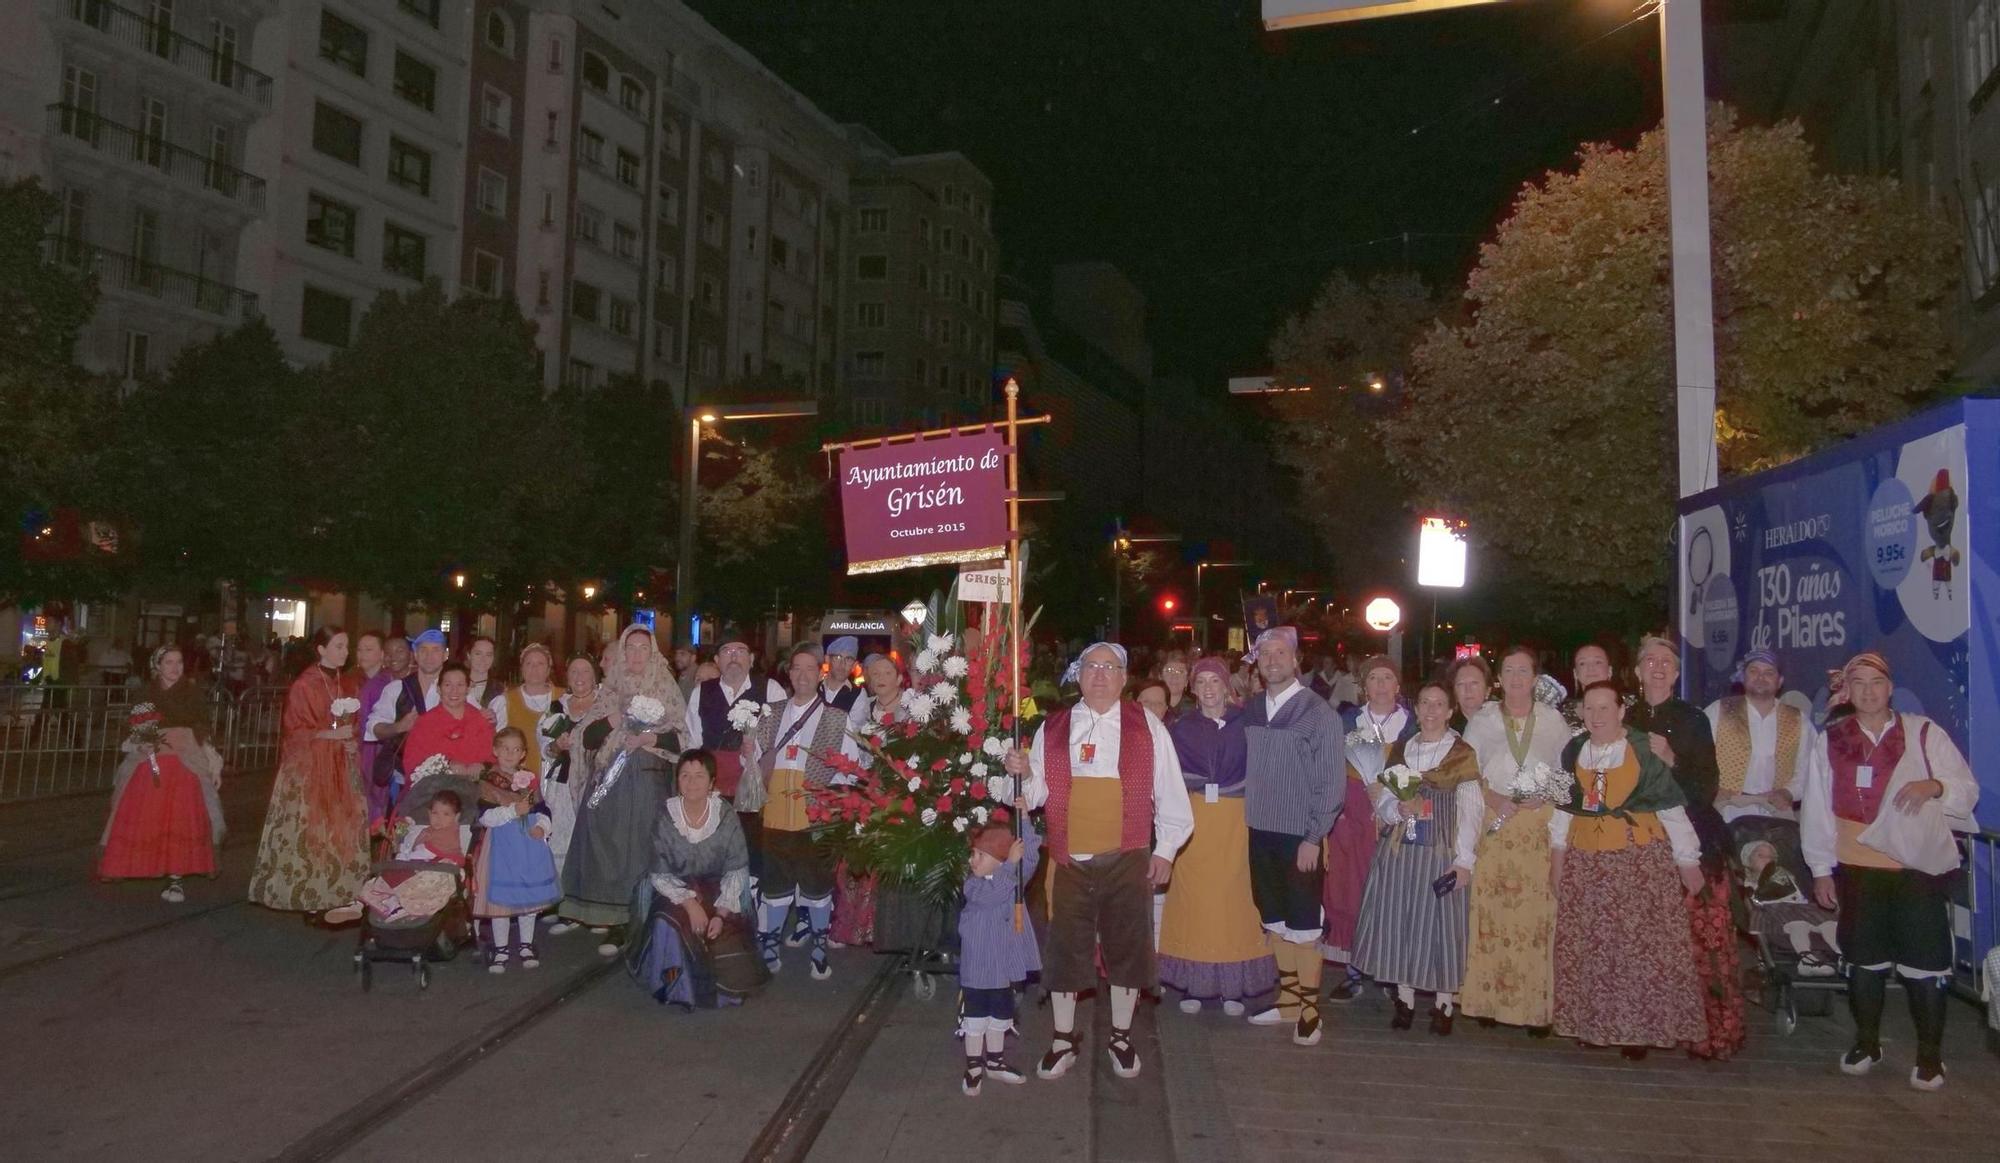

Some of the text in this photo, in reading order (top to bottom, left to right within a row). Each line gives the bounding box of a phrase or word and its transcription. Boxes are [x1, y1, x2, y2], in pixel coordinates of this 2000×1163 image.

[846, 448, 999, 490] Ayuntamiento de
[887, 481, 965, 517] Grisén
[890, 522, 966, 538] Octubre 2015
[1765, 518, 1817, 549] HERALDO
[1757, 563, 1841, 607] 130 años
[830, 622, 885, 630] AMBULANCIA
[1749, 608, 1772, 652] de
[1778, 604, 1846, 648] Pilares
